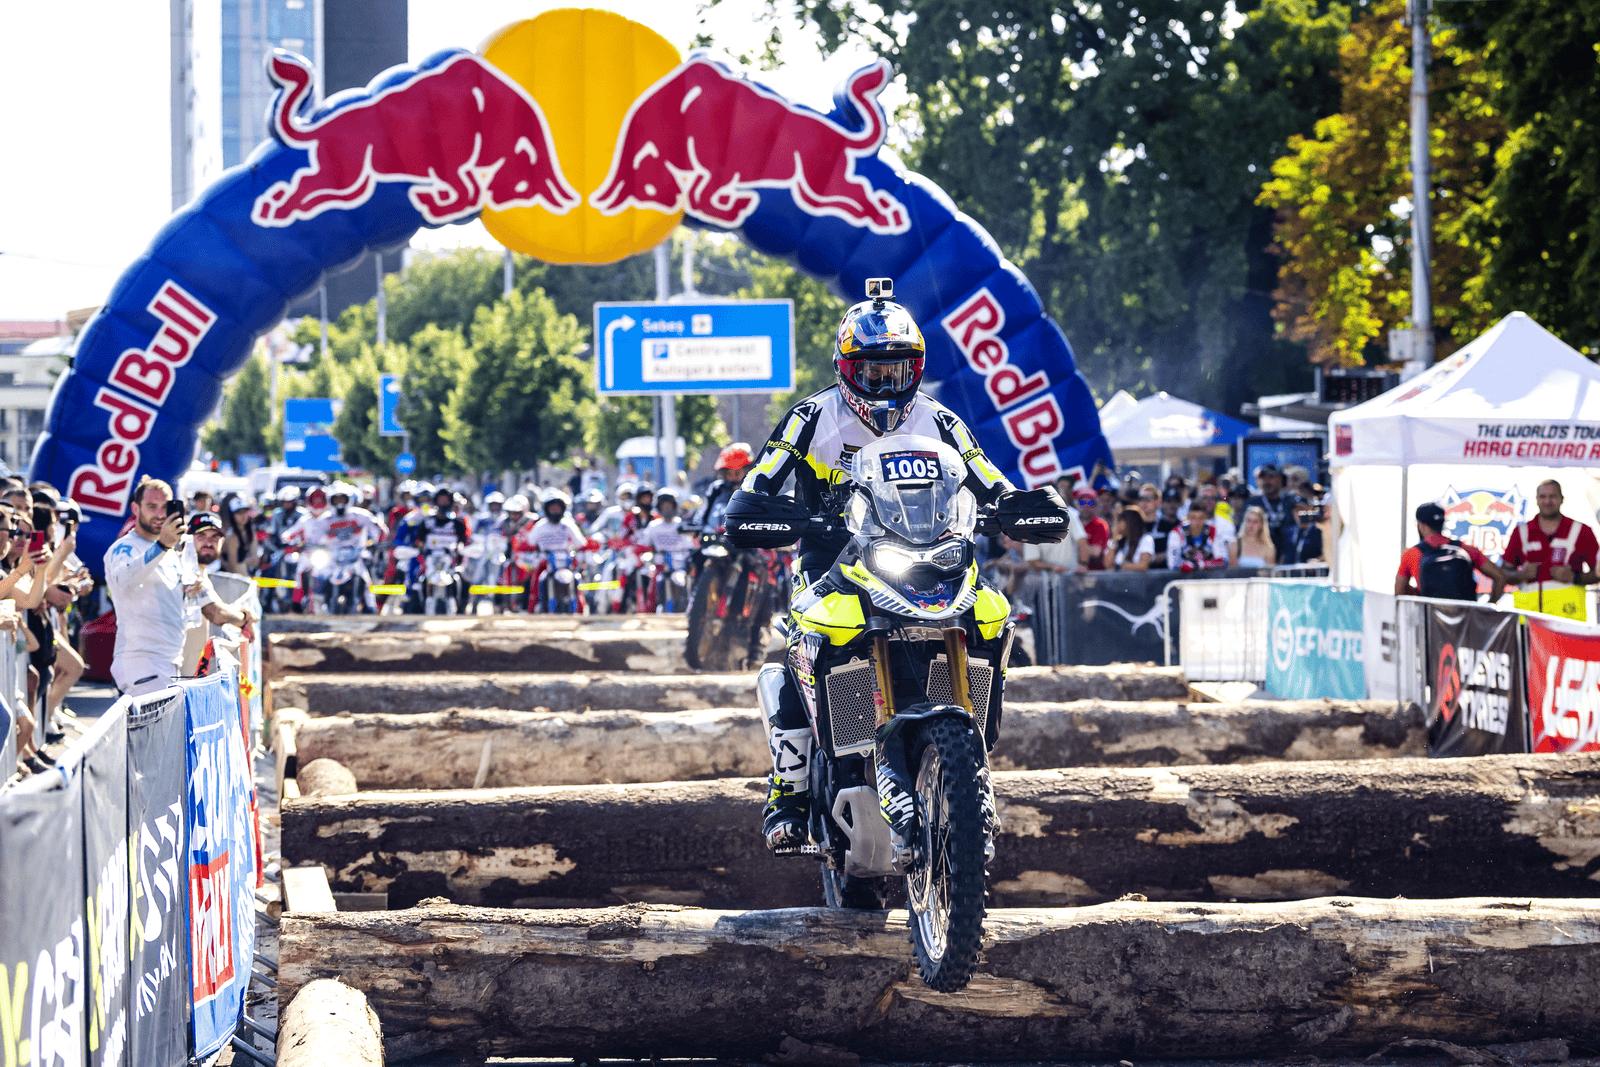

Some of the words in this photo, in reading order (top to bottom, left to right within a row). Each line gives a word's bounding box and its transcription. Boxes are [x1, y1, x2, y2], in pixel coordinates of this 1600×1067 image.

[1478, 424, 1503, 438] THE
[1463, 440, 1513, 458] HARD
[1516, 441, 1587, 460] ENDURO
[886, 459, 939, 480] 1005
[738, 523, 792, 531] ACERBIS
[1014, 516, 1064, 525] ACERBIS
